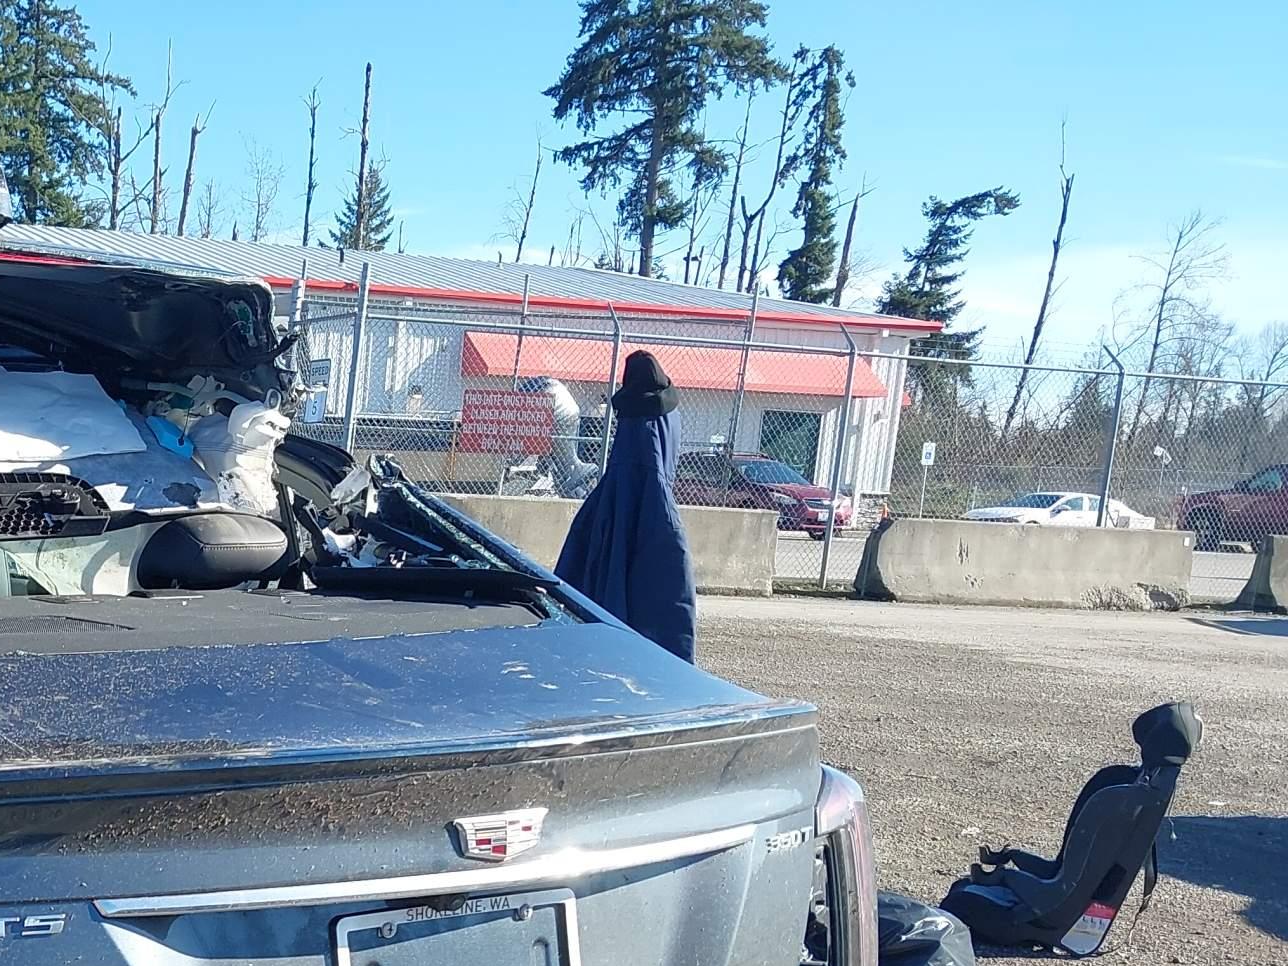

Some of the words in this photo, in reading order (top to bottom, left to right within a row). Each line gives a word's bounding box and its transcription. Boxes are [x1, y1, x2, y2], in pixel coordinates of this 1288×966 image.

[312, 366, 329, 376] SPEED
[465, 394, 482, 405] THIS
[312, 400, 318, 415] 5
[463, 423, 498, 434] BETWEEN
[490, 896, 511, 911] WA
